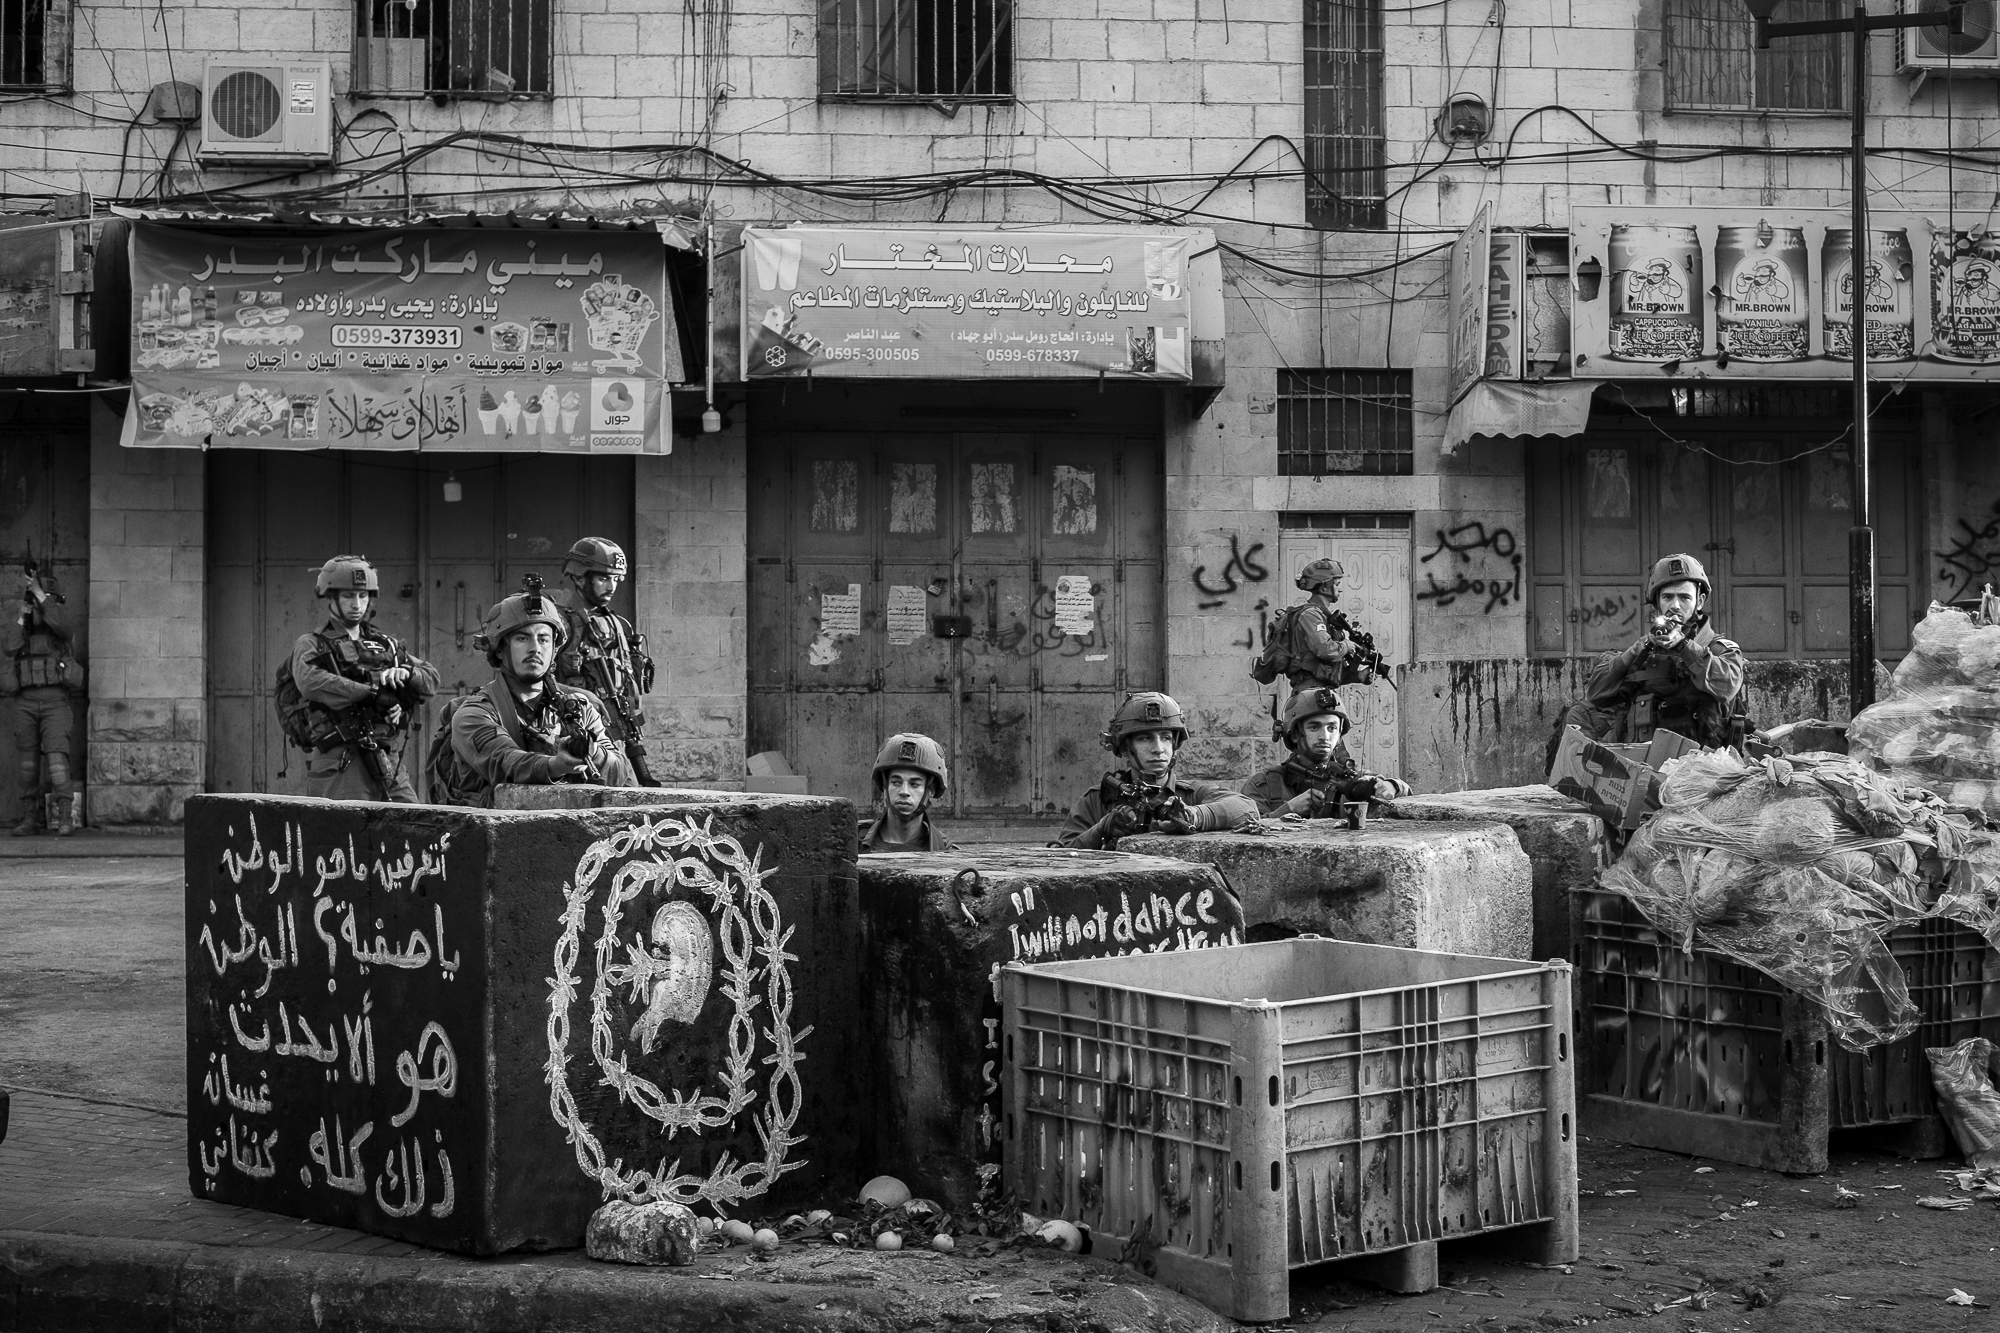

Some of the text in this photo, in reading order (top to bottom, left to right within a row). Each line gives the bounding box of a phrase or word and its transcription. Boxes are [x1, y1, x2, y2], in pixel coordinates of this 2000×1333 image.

[190, 236, 603, 294] ميني ماركت البدر
[820, 242, 1114, 276] محلات المختار
[389, 299, 435, 319] يحيى
[788, 285, 1149, 320] للنايلون والبلاستيك ومستلزمات المطاعم
[1634, 317, 1678, 327] CAPPUCCINO
[1744, 318, 1781, 328] VANILLA
[337, 327, 458, 346] 0599-373931
[843, 328, 901, 343] عبد الناصر
[1050, 331, 1079, 345] الحاج
[245, 347, 288, 372] أجبان
[306, 348, 342, 373] ألبان
[362, 352, 412, 374] غذائية
[825, 347, 920, 361] 0595-300505
[986, 349, 1080, 362] 0599-678337
[416, 354, 448, 375] مواد
[468, 355, 526, 375] تموينية
[530, 355, 563, 375] مواد
[604, 415, 631, 426] جوال
[592, 437, 642, 447] ooredoo
[1112, 888, 1220, 943] dance
